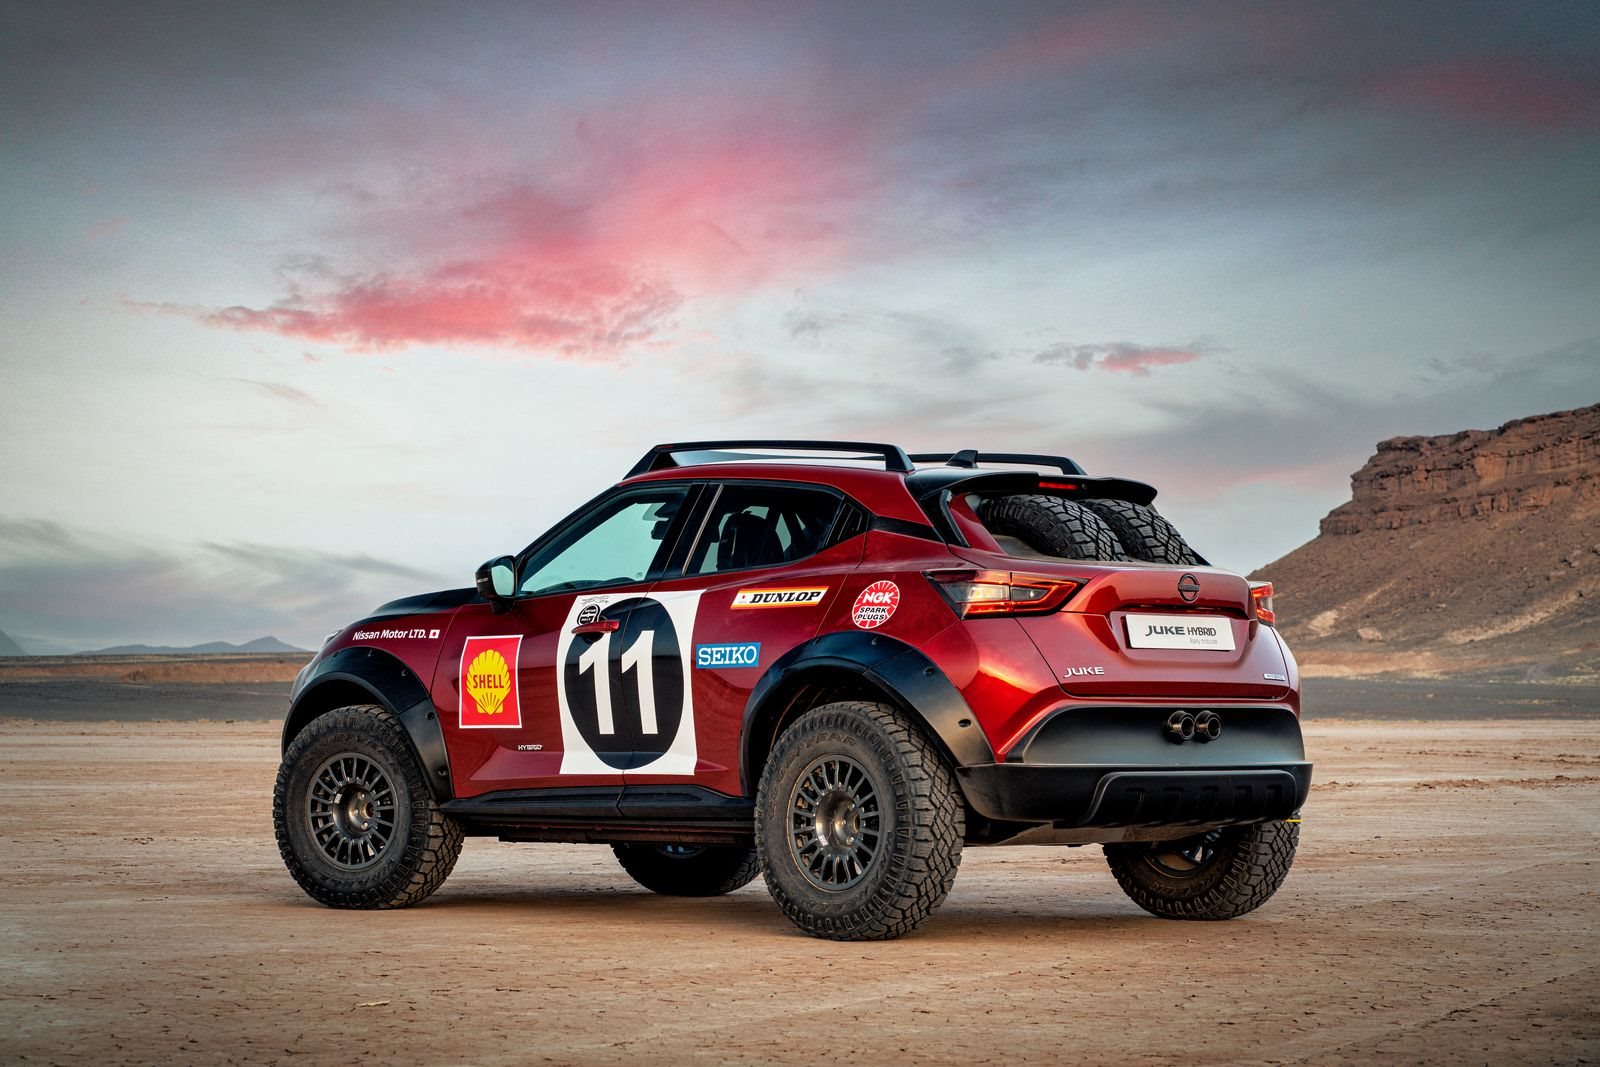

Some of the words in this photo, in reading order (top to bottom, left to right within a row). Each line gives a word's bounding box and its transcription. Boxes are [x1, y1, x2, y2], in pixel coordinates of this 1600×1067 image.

[749, 591, 822, 604] DUNLOP
[862, 592, 895, 604] NGK
[352, 630, 380, 641] Nissan
[380, 629, 408, 639] Motor
[408, 629, 427, 639] LTD.
[1145, 625, 1186, 636] JUKE
[1187, 627, 1216, 636] HYBRID
[698, 645, 757, 666] SEIKO
[1064, 666, 1105, 678] JUKE
[473, 674, 505, 689] SHELL
[579, 630, 658, 735] 11
